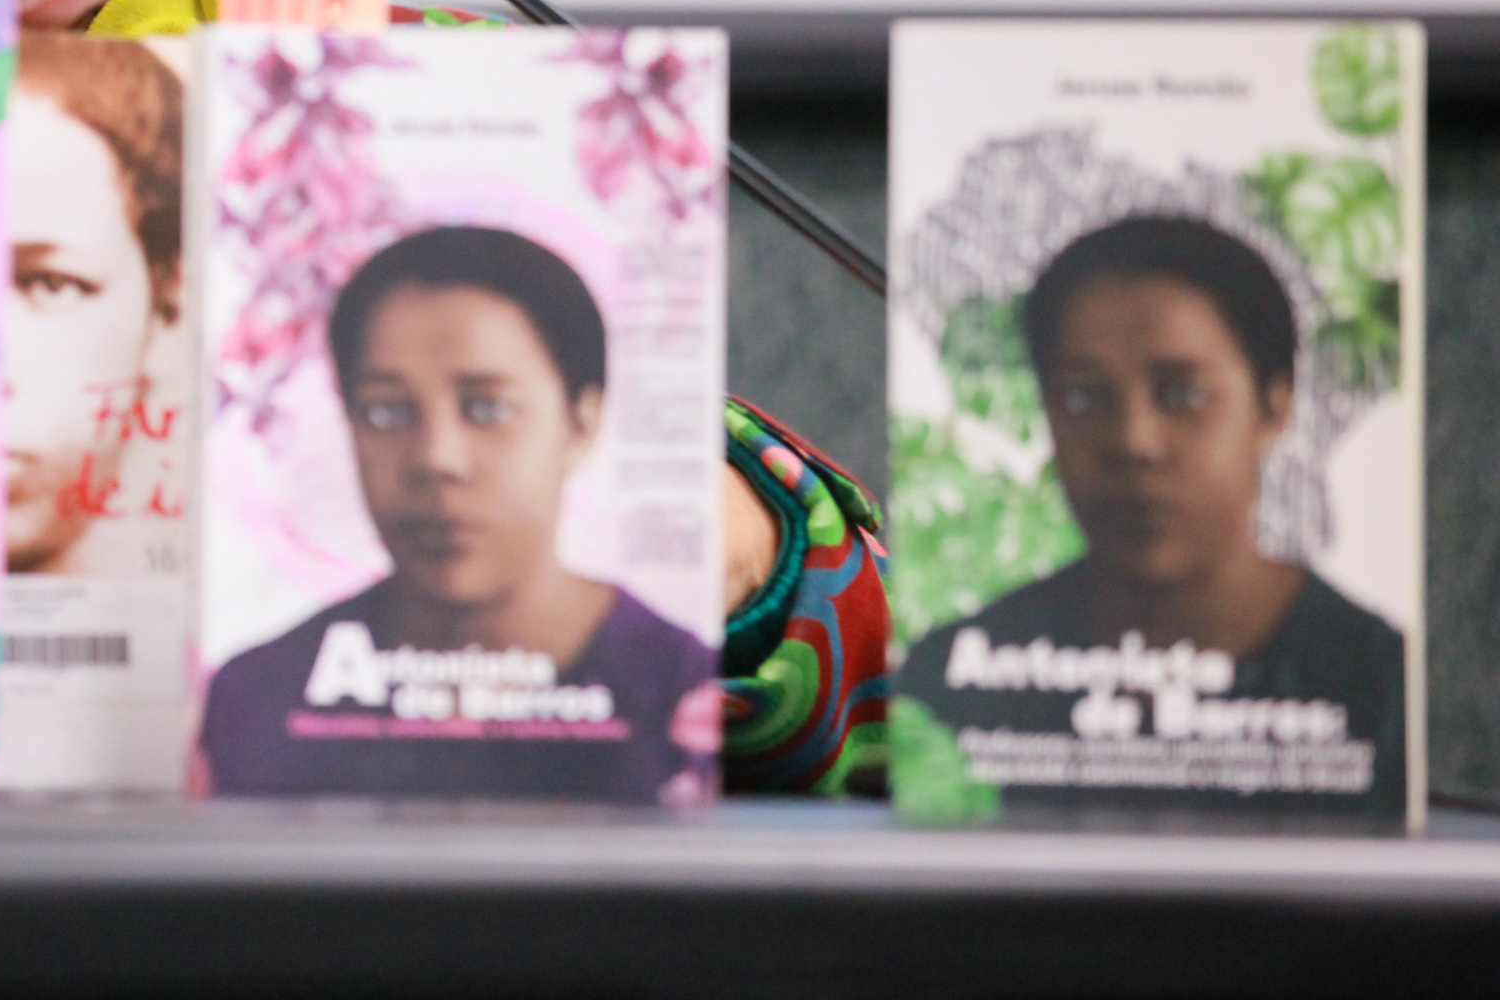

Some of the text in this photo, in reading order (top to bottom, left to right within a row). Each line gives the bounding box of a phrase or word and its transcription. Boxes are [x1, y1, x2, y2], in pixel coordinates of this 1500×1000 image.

[303, 618, 557, 707] Antonieta
[944, 626, 1236, 694] Antonieta
[391, 680, 455, 722] de
